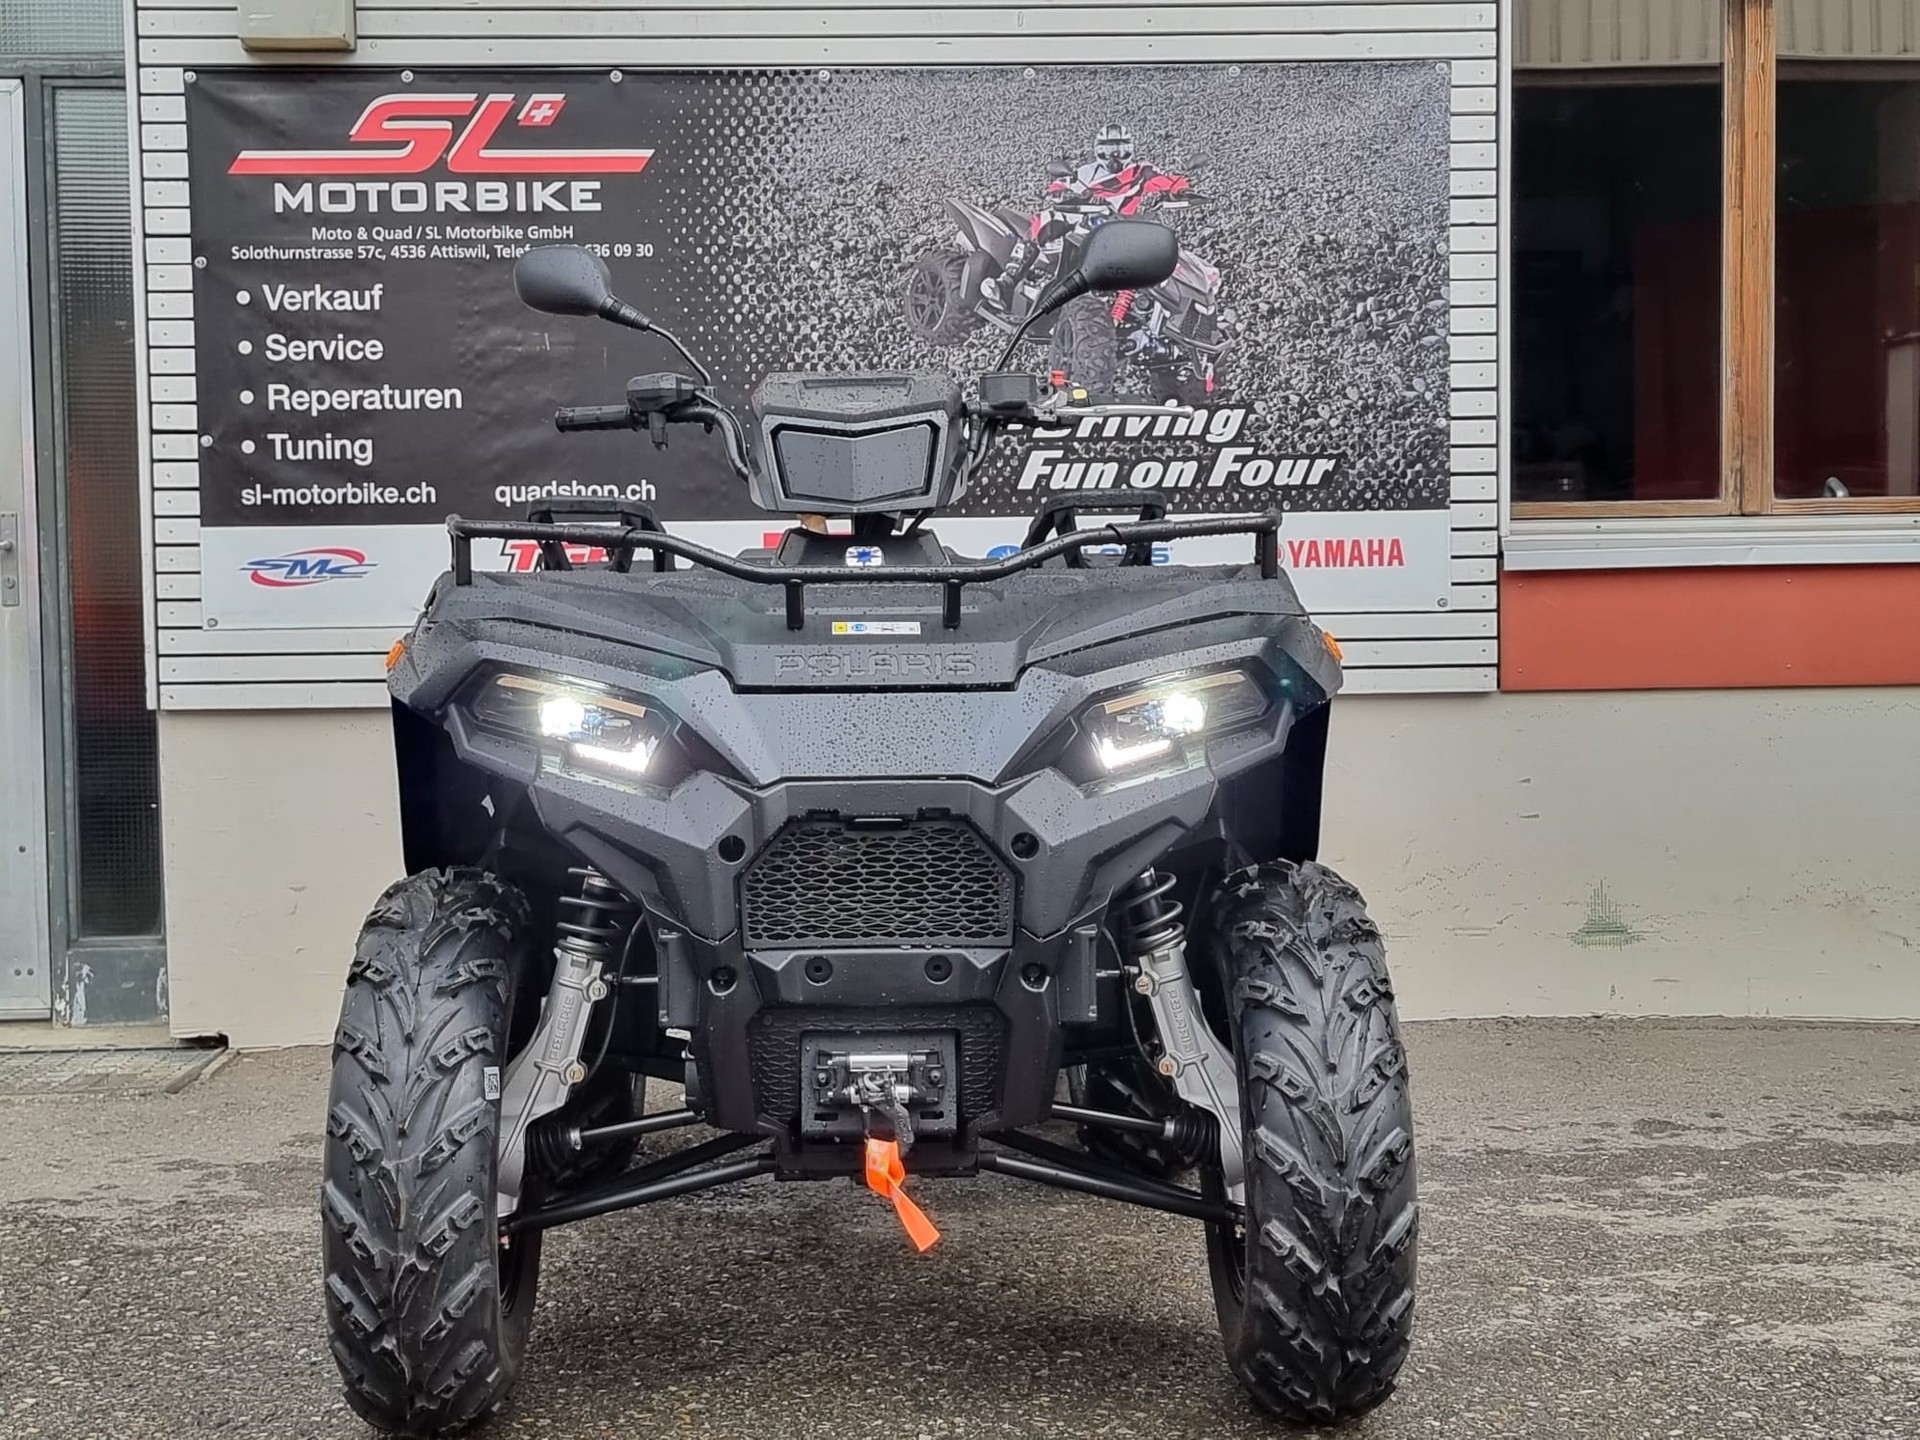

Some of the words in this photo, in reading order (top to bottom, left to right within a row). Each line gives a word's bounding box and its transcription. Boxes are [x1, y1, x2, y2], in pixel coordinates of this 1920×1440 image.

[274, 181, 602, 213] MOTORBIKE
[311, 226, 353, 241] Moto
[356, 226, 369, 241] &
[371, 226, 413, 242] Quad
[415, 225, 423, 241] /
[425, 225, 443, 240] SL
[445, 224, 524, 240] Motorbike
[527, 224, 574, 239] GmbH
[231, 244, 354, 260] Solothurnstrasse
[357, 244, 387, 260] 57c,
[390, 244, 427, 259] 4536
[429, 243, 490, 260] Attiswil,
[613, 243, 632, 258] 09
[635, 243, 654, 258] 30
[261, 283, 384, 312] Verkauf
[265, 333, 384, 362] Service
[267, 383, 463, 416] Reperaturen
[266, 432, 374, 466] Tuning
[1017, 449, 1119, 490] Fun
[1129, 460, 1199, 488] on
[1206, 447, 1337, 488] Four
[241, 481, 436, 505] sl-motorbike.ch
[238, 558, 379, 576] SMC
[1288, 537, 1406, 569] YAMAHA
[774, 653, 977, 678] POLARIS
